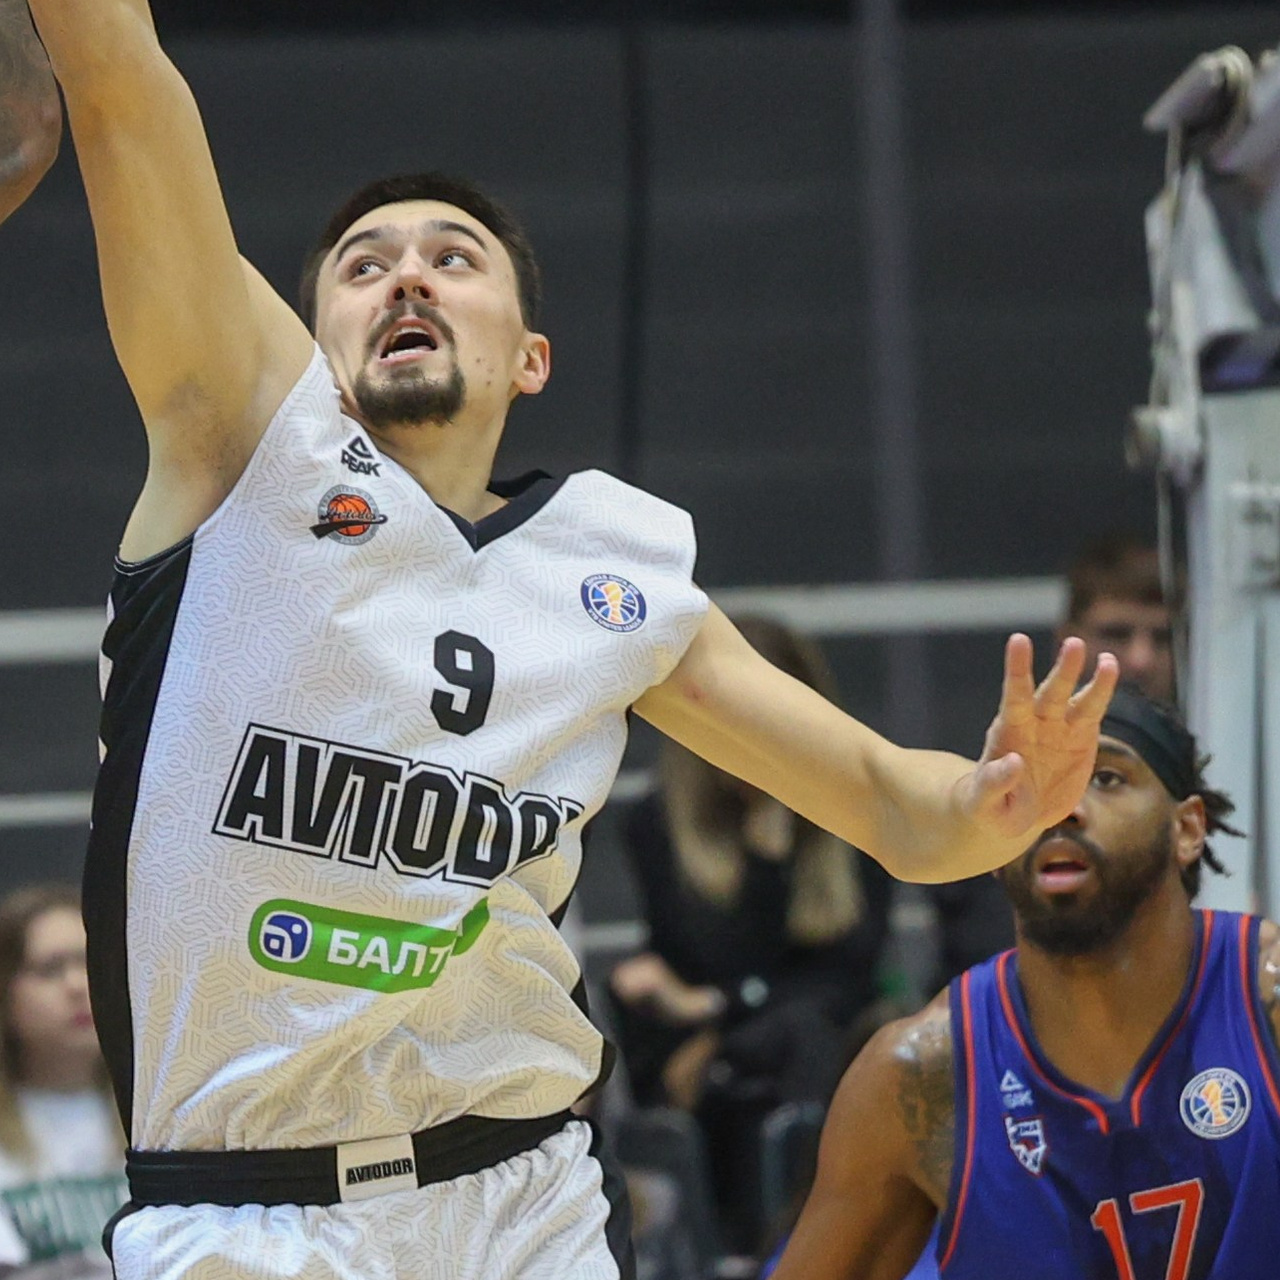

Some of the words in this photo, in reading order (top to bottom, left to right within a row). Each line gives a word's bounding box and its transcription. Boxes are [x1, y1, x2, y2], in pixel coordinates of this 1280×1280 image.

[340, 449, 382, 478] PEAK
[430, 628, 495, 737] 9
[326, 928, 452, 978] БАЛТ
[346, 1157, 414, 1186] AVTODOR
